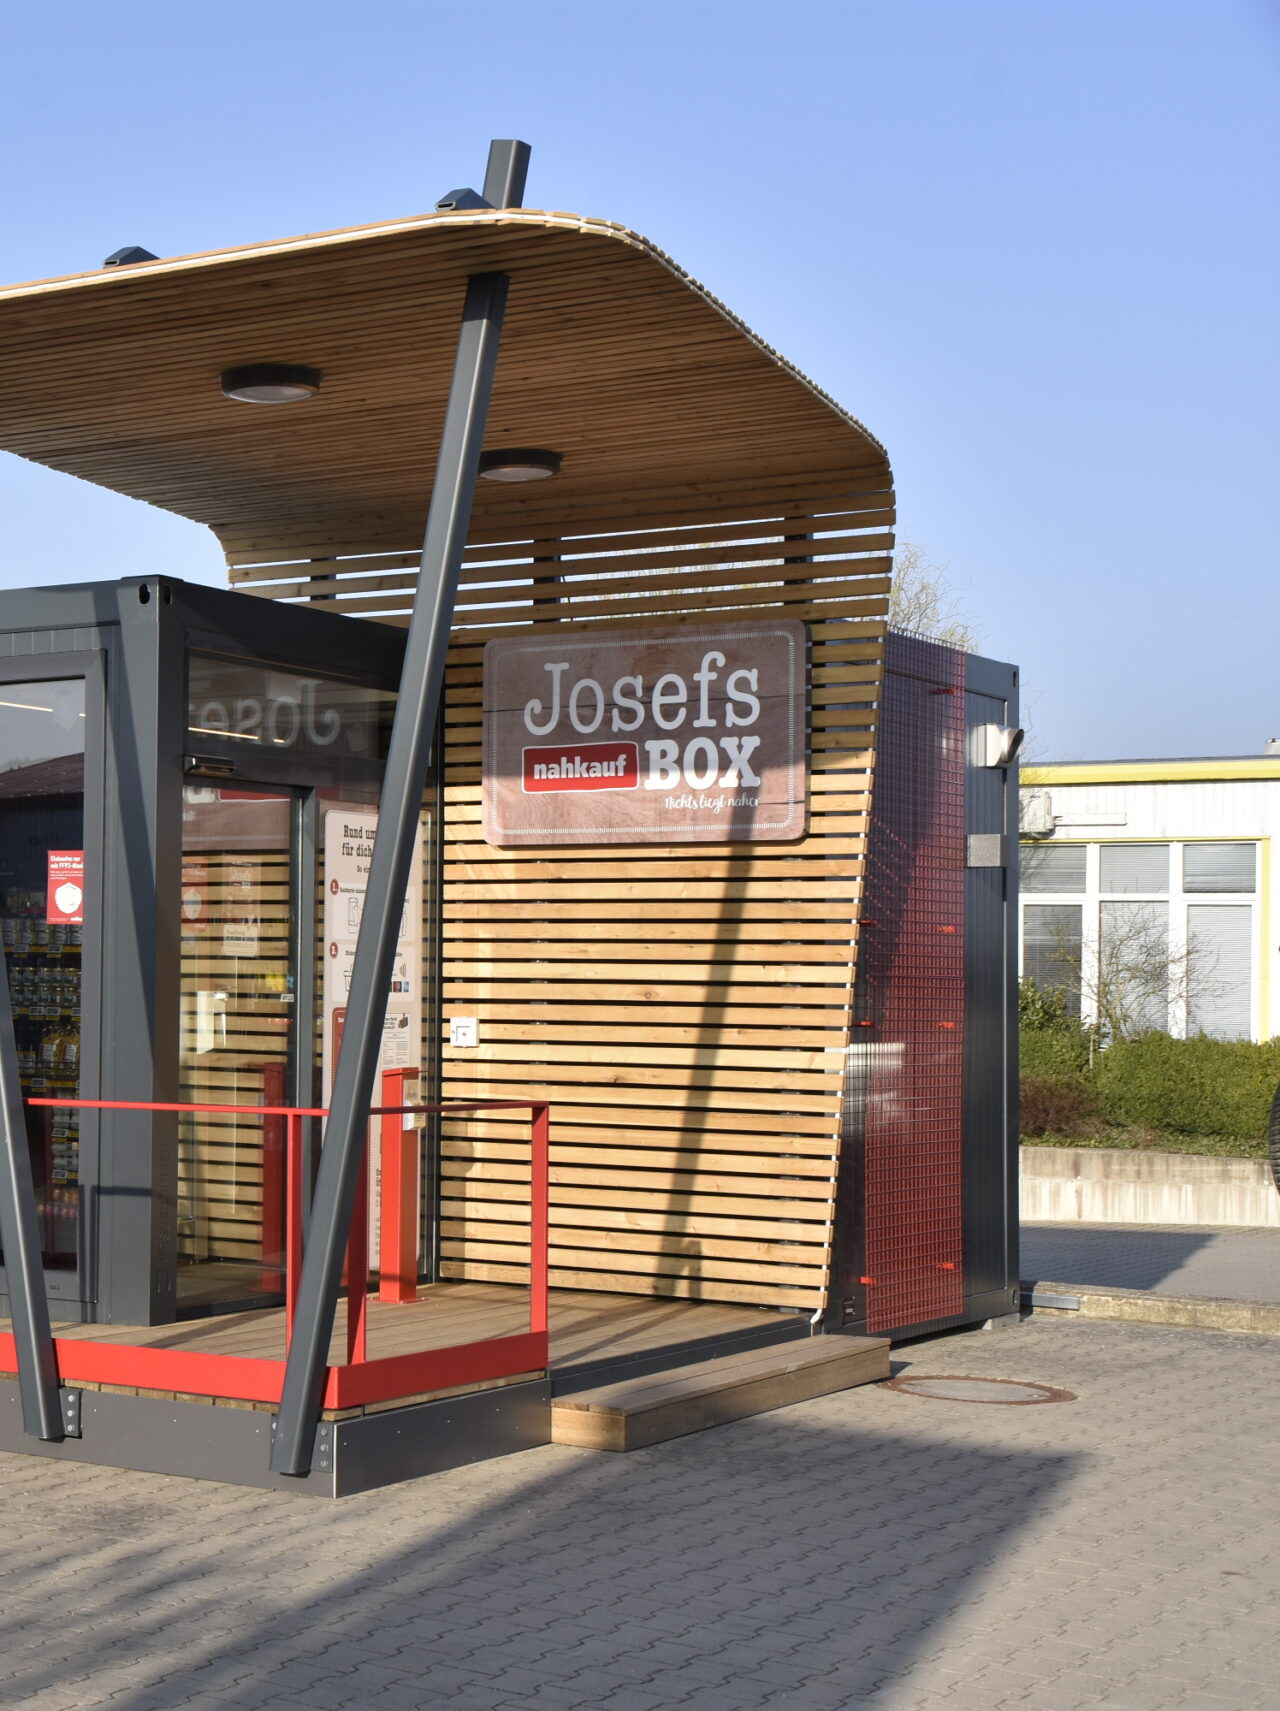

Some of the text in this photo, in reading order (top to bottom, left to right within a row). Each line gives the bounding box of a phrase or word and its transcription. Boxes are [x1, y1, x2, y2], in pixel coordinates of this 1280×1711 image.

[524, 651, 760, 736] Josefs
[533, 754, 627, 780] nahkauf
[644, 736, 761, 790] BOX
[700, 794, 726, 814] liegt
[344, 825, 363, 839] Rund
[342, 843, 354, 856] für
